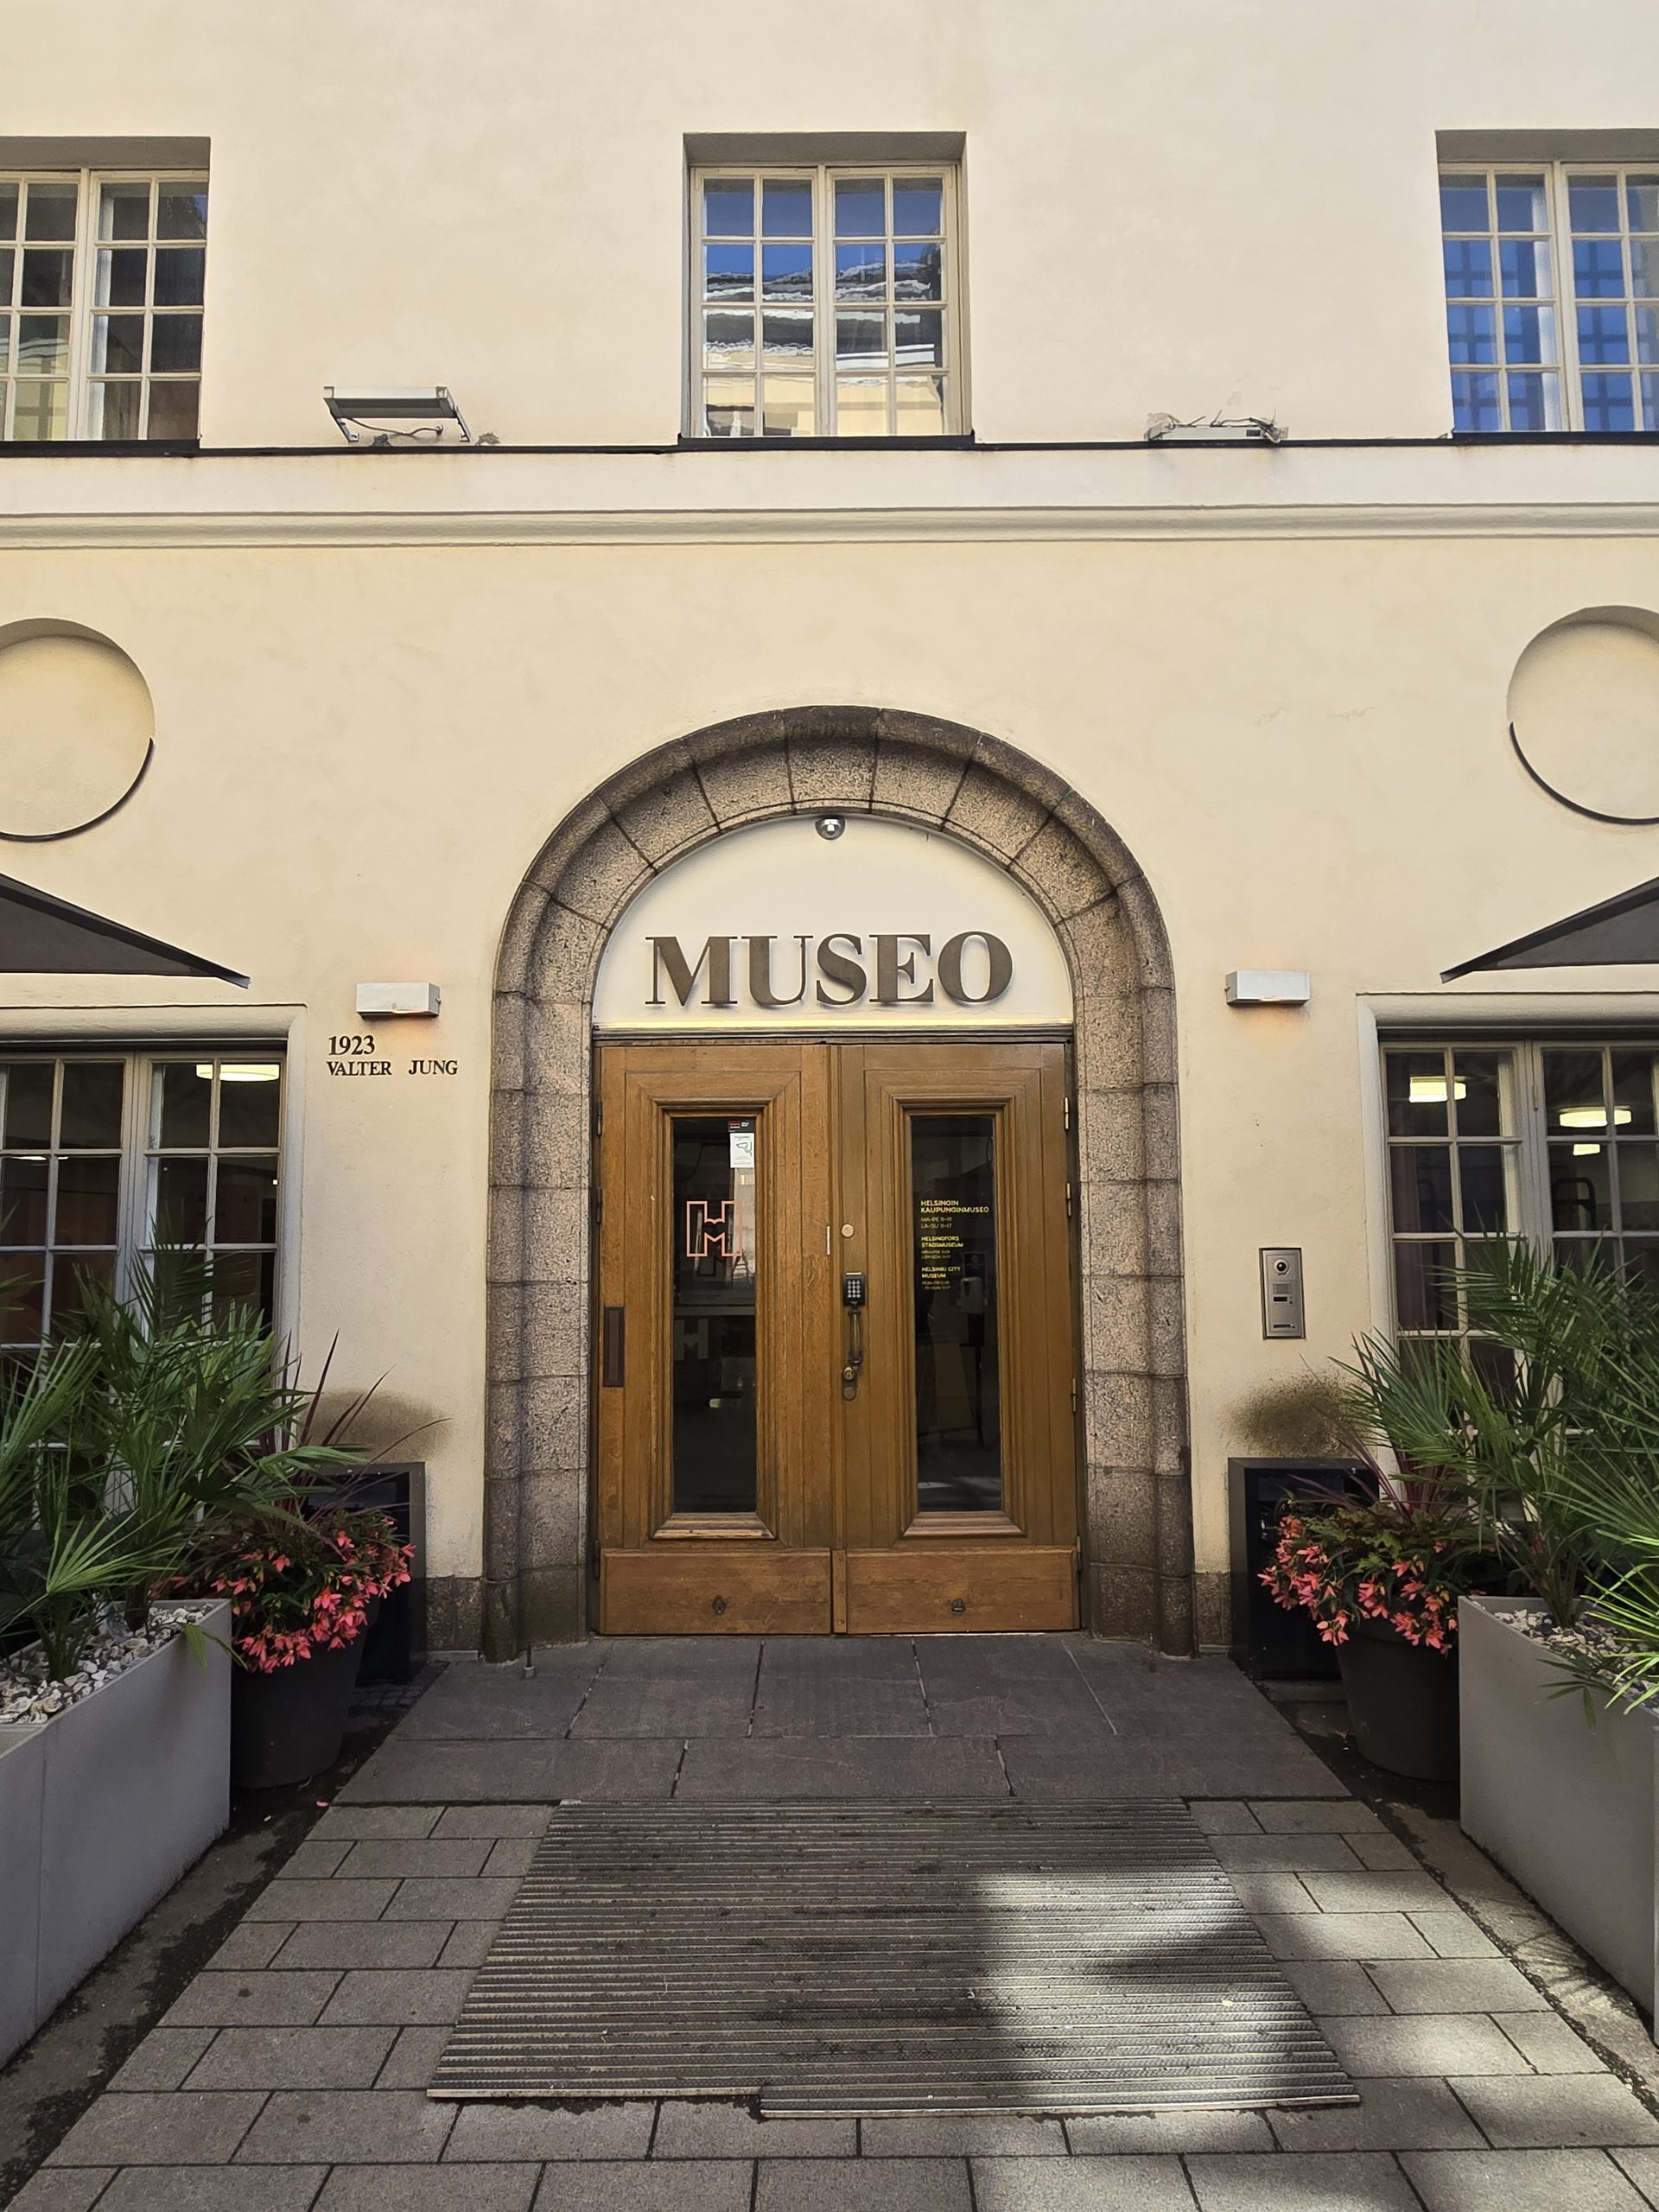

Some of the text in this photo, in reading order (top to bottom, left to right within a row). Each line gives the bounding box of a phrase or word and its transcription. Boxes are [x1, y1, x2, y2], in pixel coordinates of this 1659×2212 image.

[645, 931, 1013, 1007] MUSEO
[328, 1034, 375, 1056] 1923
[326, 1059, 458, 1076] VALTER JUNG
